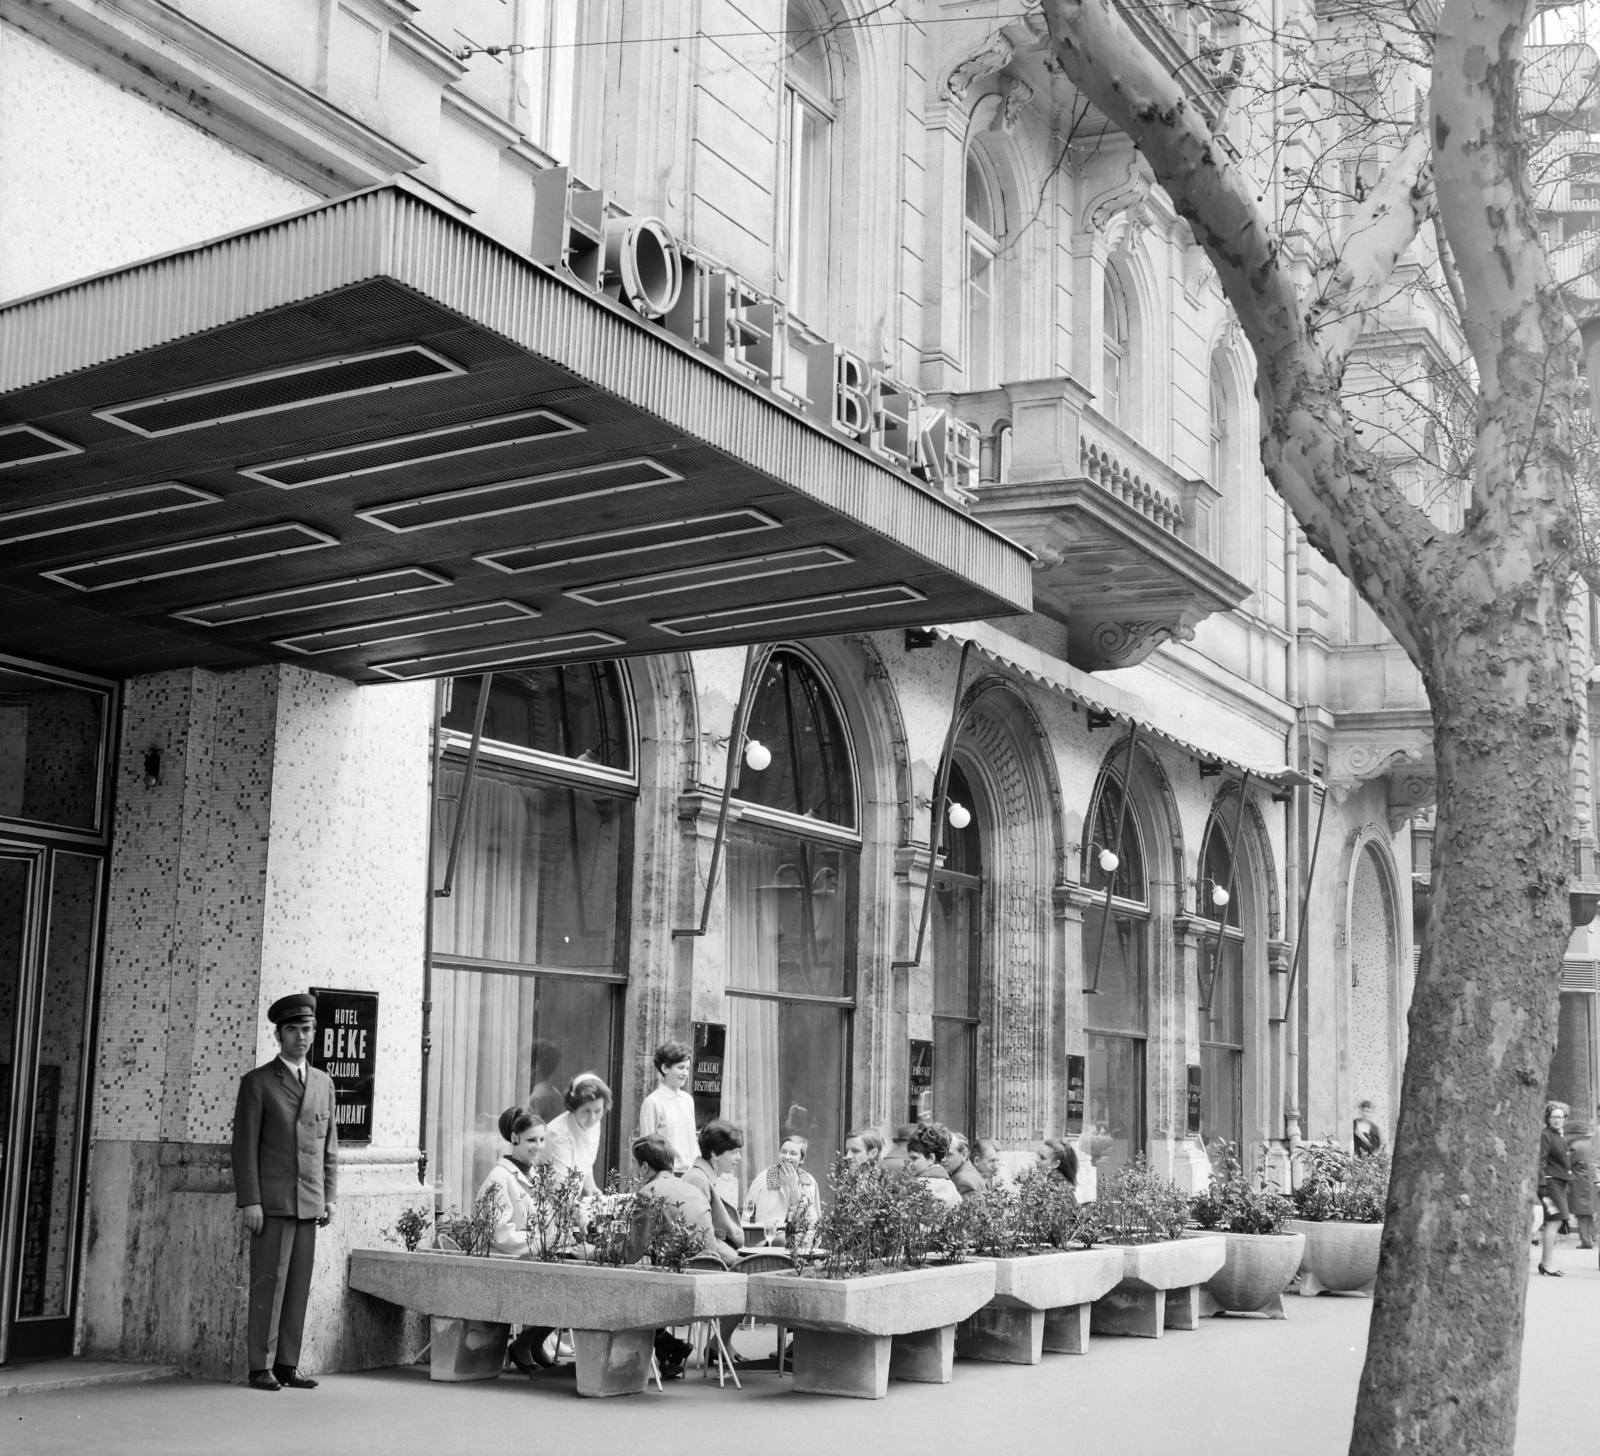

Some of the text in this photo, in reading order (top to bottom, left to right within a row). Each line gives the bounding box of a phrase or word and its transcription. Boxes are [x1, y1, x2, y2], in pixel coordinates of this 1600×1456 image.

[533, 164, 814, 408] HOTEL
[334, 1008, 359, 1025] HOTEL
[323, 1025, 367, 1059] BÉKE
[326, 1060, 360, 1078] SZÁLLODA
[697, 1061, 720, 1074] ALKALMI
[335, 1104, 367, 1125] AURANT
